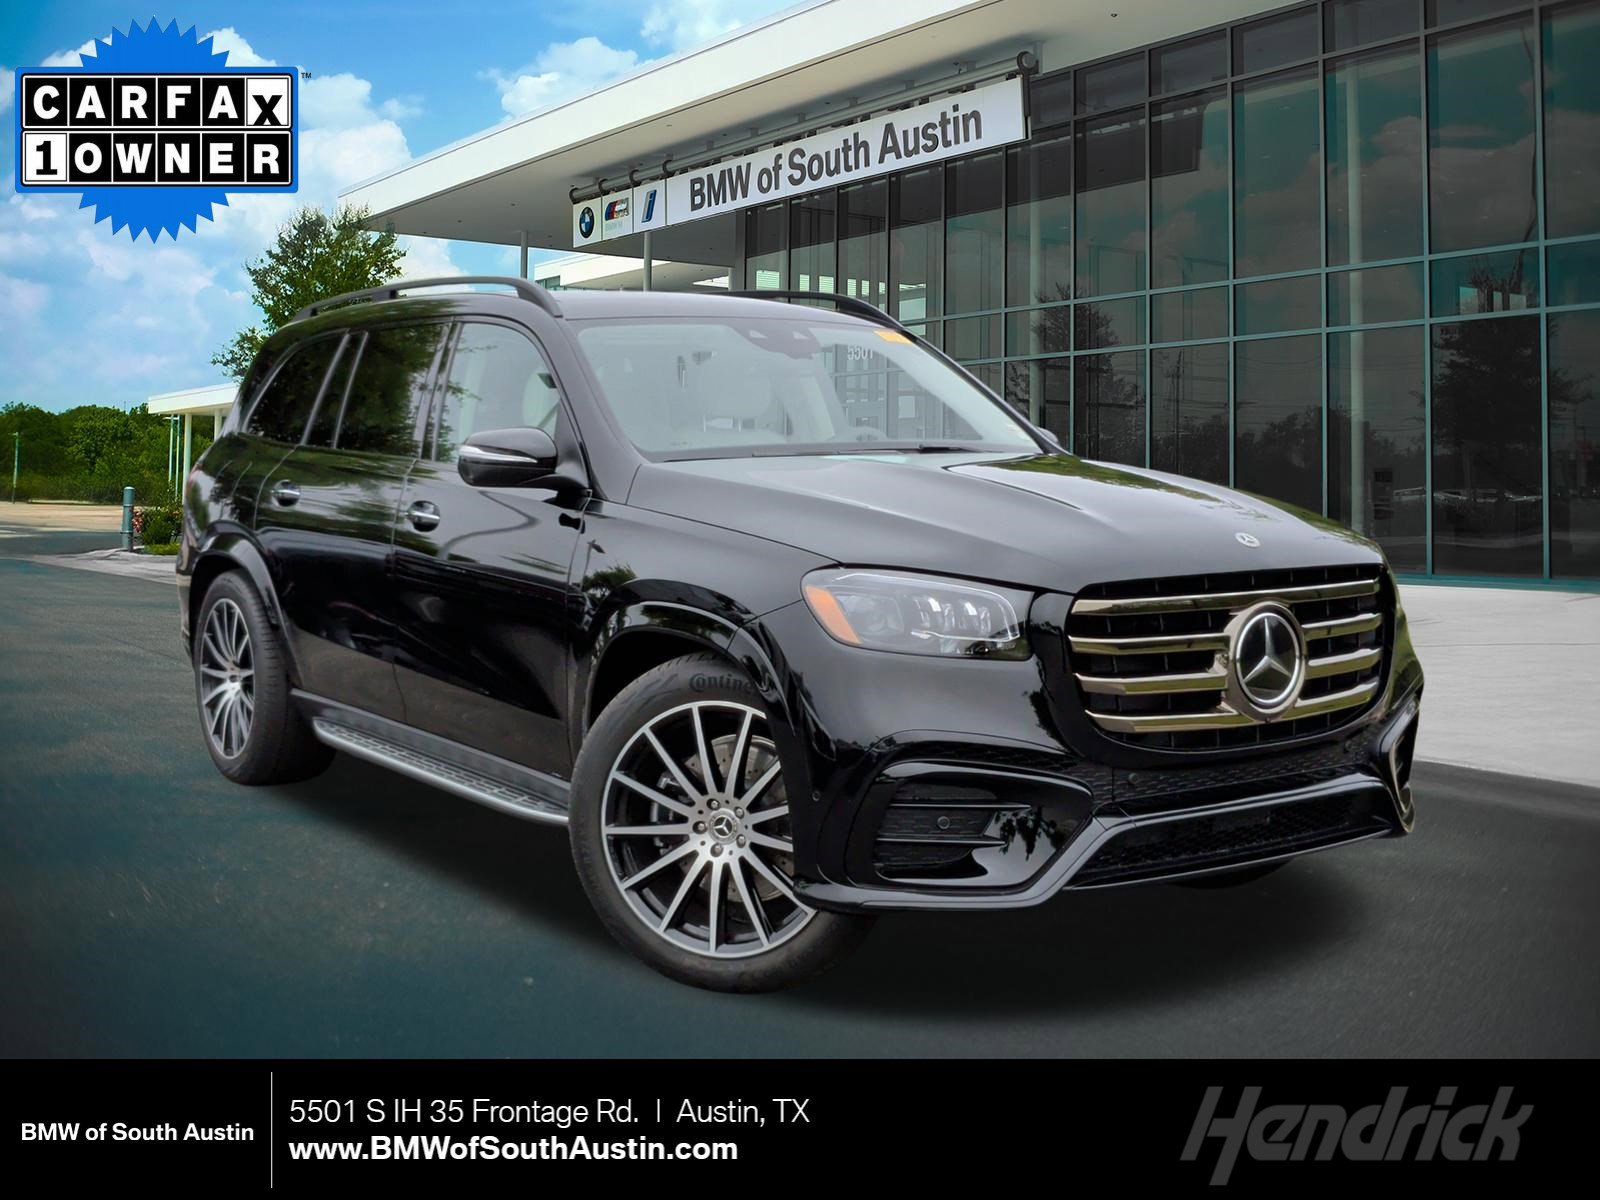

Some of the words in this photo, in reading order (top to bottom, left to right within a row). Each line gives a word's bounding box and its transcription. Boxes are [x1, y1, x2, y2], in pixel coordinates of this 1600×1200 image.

[690, 162, 751, 212] BMW
[757, 153, 783, 194] of
[787, 132, 871, 186] South
[878, 103, 983, 164] Austin
